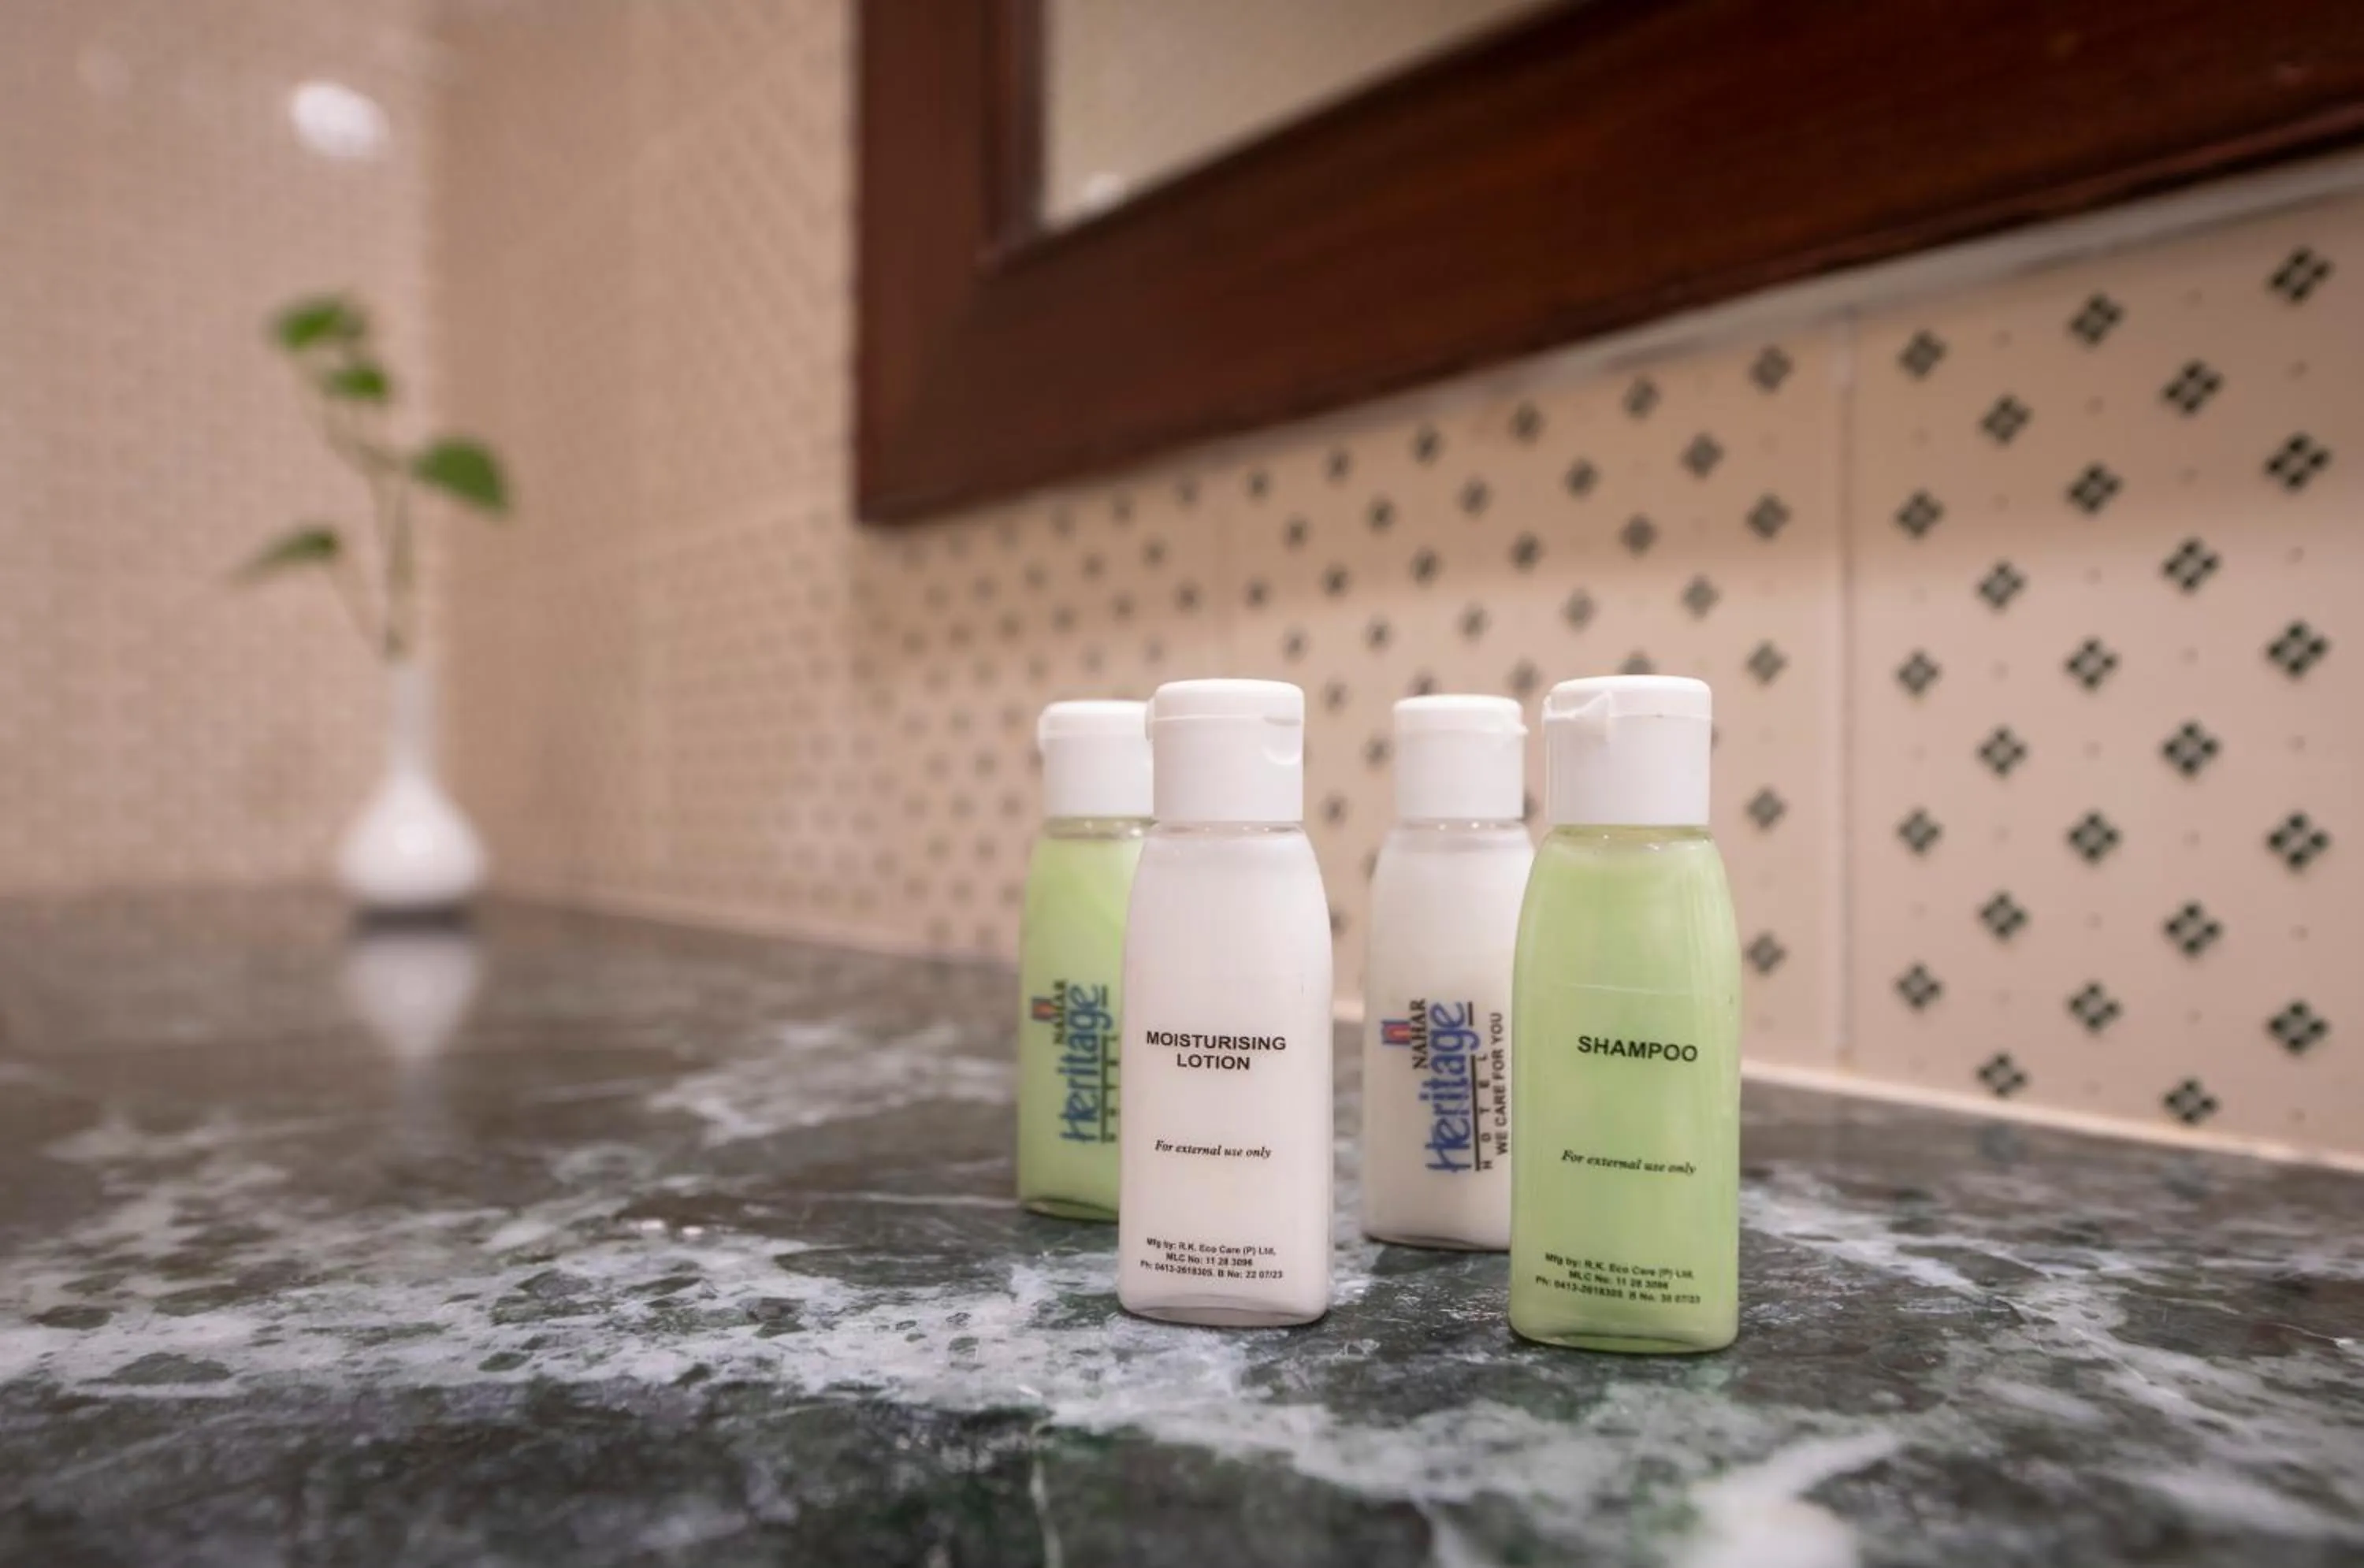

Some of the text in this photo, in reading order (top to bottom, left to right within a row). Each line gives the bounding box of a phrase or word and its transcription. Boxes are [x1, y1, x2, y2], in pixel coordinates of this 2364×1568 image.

[1147, 1031, 1286, 1050] MOISTURISING
[1409, 998, 1429, 1069] NAHAR
[1577, 1035, 1698, 1062] SHAMPOO
[1176, 1053, 1251, 1070] LOTION
[1419, 1001, 1481, 1172] Heritage
[1489, 1012, 1508, 1156] WE CARE FOR YOU
[1154, 1139, 1173, 1152] For
[1176, 1145, 1221, 1156] external
[1246, 1146, 1272, 1159] only
[1561, 1149, 1697, 1176] For external use only
[1147, 1237, 1162, 1249] Mfg
[1163, 1239, 1176, 1250] by:
[1178, 1241, 1196, 1251] R.K.
[1199, 1243, 1217, 1254] Eco
[1219, 1245, 1241, 1254] Care
[1243, 1246, 1255, 1255] (P)
[1140, 1259, 1151, 1268] Ph:
[1165, 1252, 1186, 1261] MLC
[1188, 1254, 1202, 1264] No:
[1206, 1256, 1215, 1265] 11
[1544, 1252, 1563, 1266] Mfg
[1608, 1262, 1629, 1273] Eco
[1631, 1265, 1656, 1276] Care
[1569, 1270, 1592, 1281] MLC
[1616, 1276, 1627, 1286] 11
